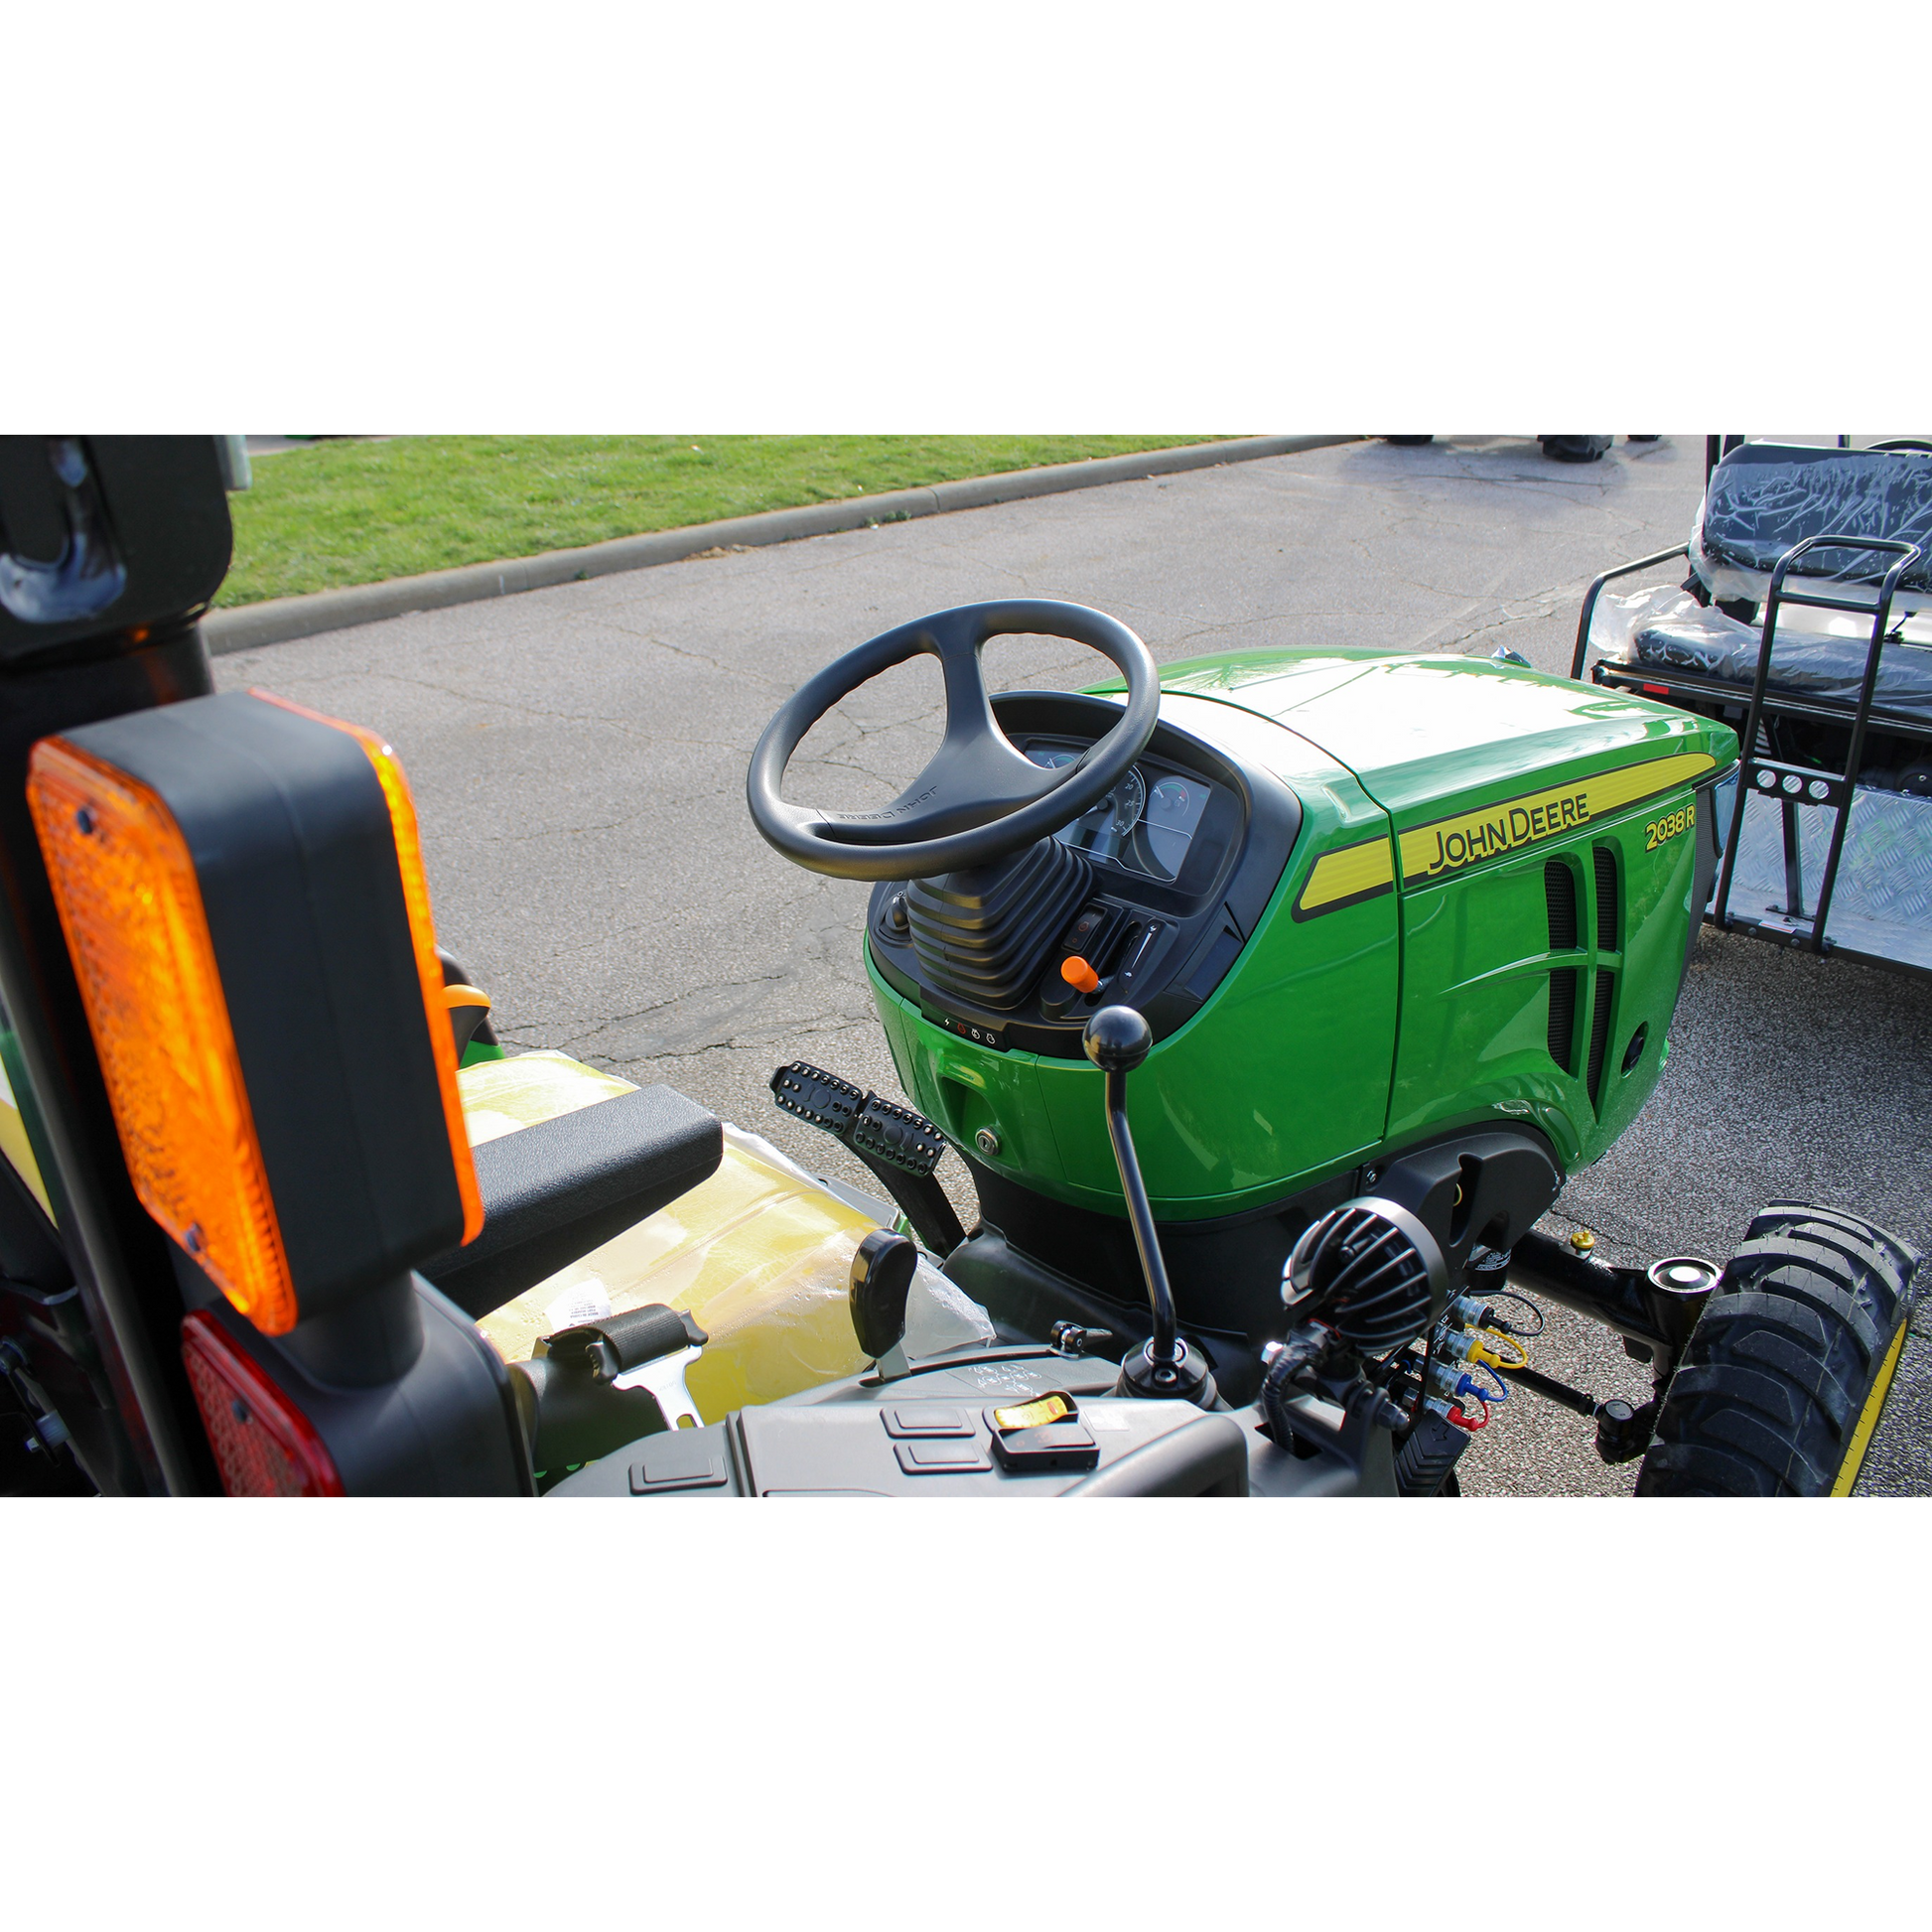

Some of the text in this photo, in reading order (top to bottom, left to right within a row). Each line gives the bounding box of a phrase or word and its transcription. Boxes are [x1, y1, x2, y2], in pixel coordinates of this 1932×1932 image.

[837, 785, 937, 820] JOHN DEERE
[1428, 792, 1591, 875] JOHN DEERE
